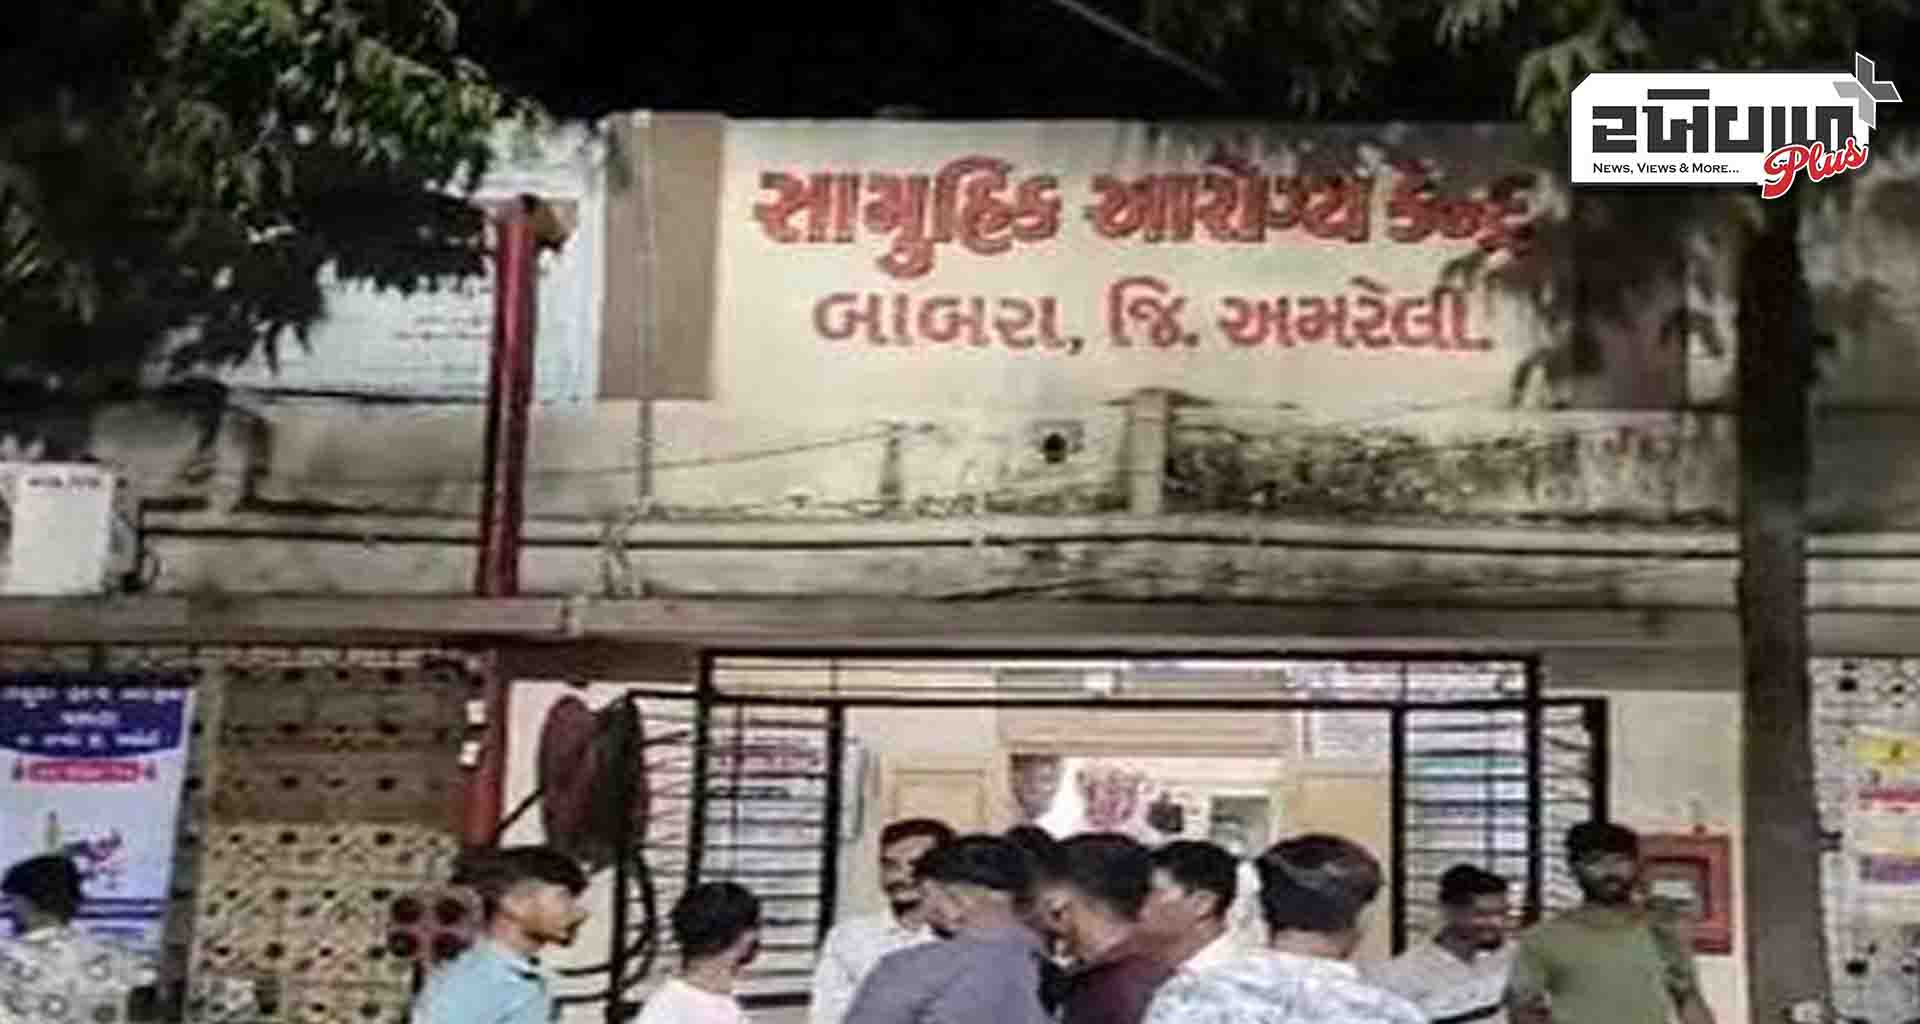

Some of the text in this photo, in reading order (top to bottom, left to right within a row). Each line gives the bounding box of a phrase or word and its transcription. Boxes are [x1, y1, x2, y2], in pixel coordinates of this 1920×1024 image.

[1083, 158, 1374, 243] આરોગ્ય
[813, 292, 1083, 354] બાબરા,
[1110, 275, 1199, 348] જિ.
